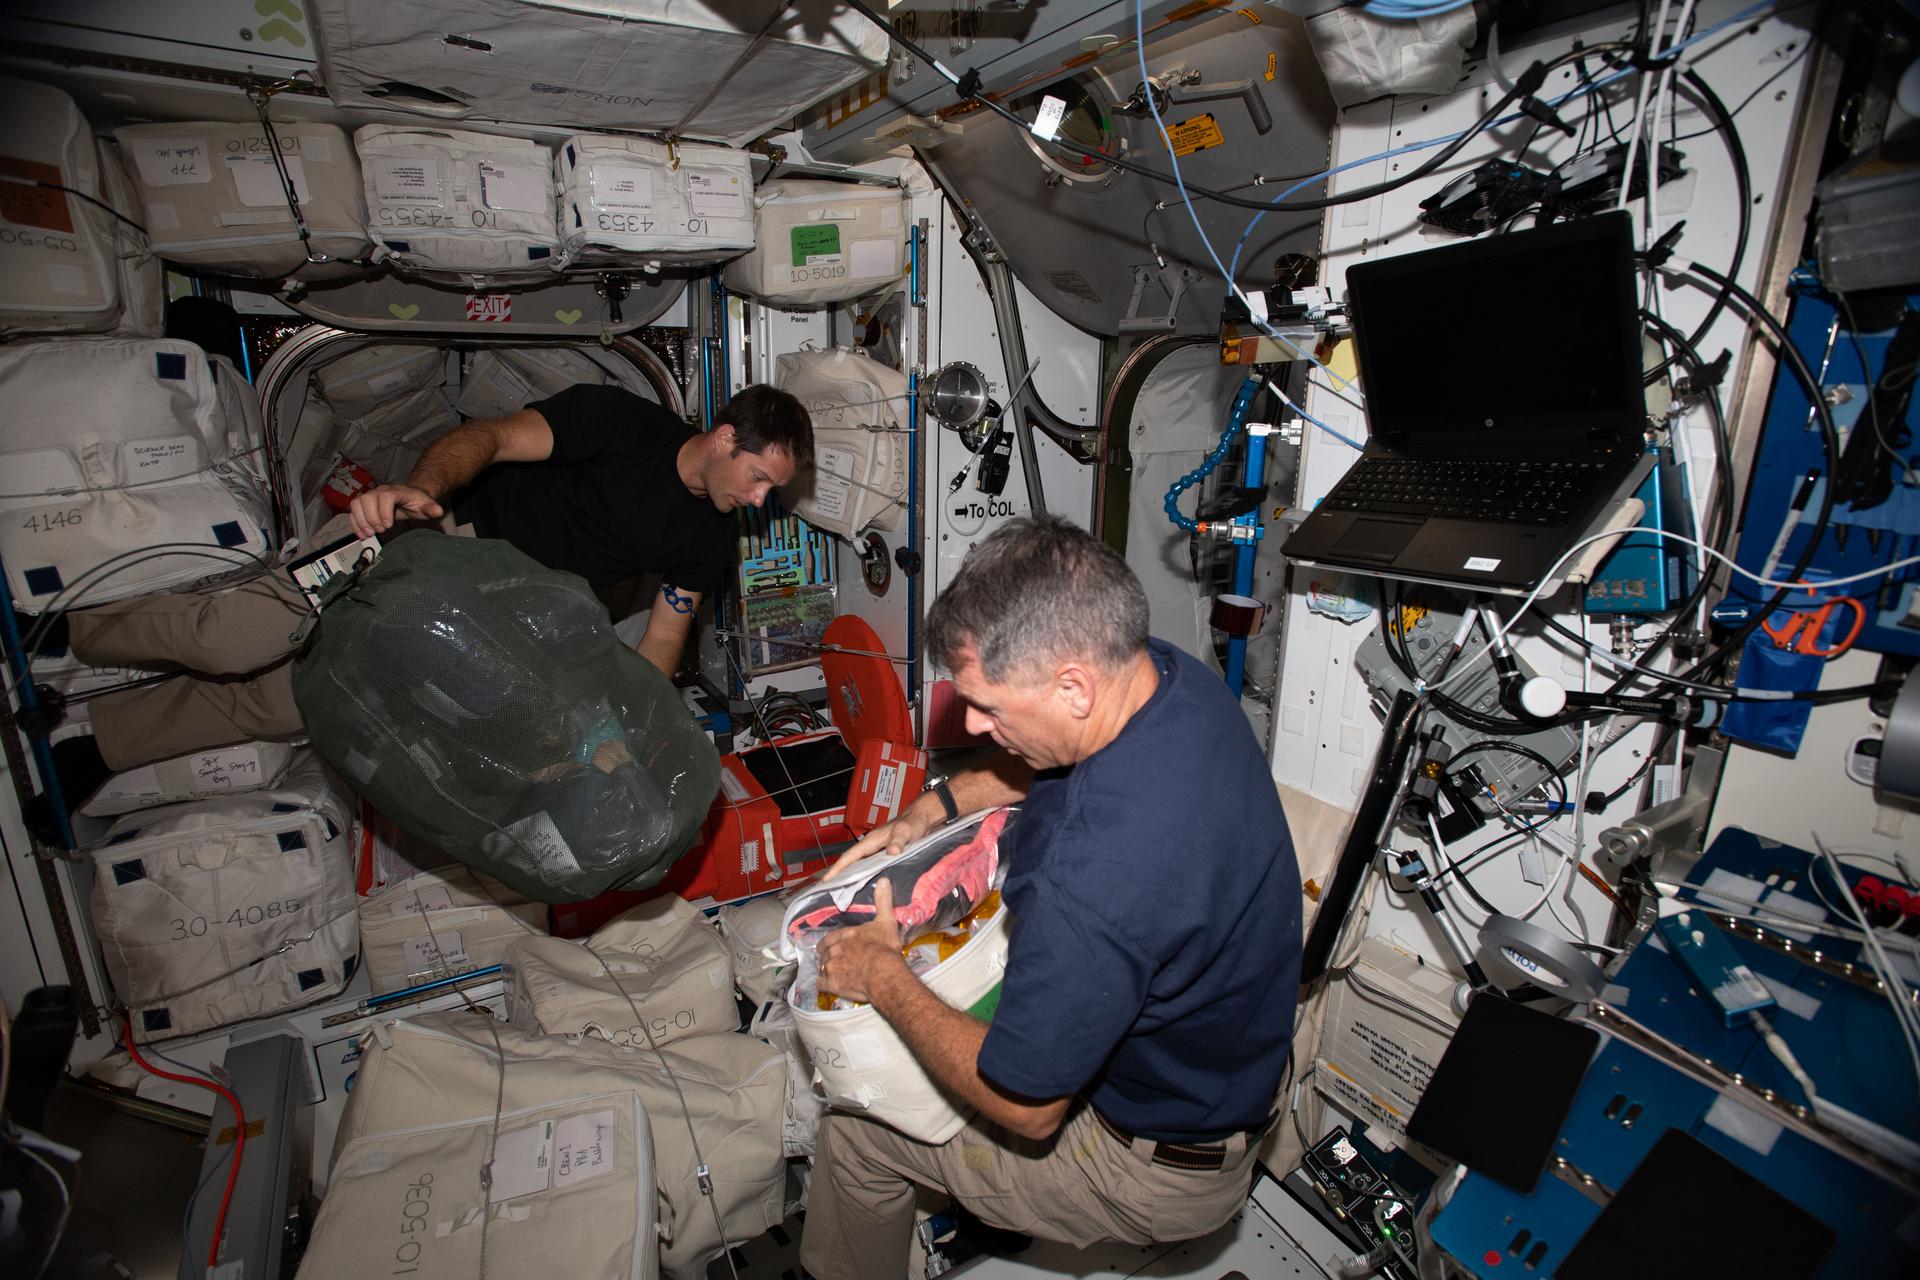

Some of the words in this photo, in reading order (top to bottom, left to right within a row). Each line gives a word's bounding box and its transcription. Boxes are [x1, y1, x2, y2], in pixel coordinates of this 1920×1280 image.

[1175, 123, 1202, 136] WARNING
[170, 162, 199, 176] 77P
[597, 213, 655, 234] 4353
[472, 297, 505, 317] EXIT
[968, 502, 985, 518] To
[988, 501, 1016, 518] COL
[22, 507, 83, 535] 4146
